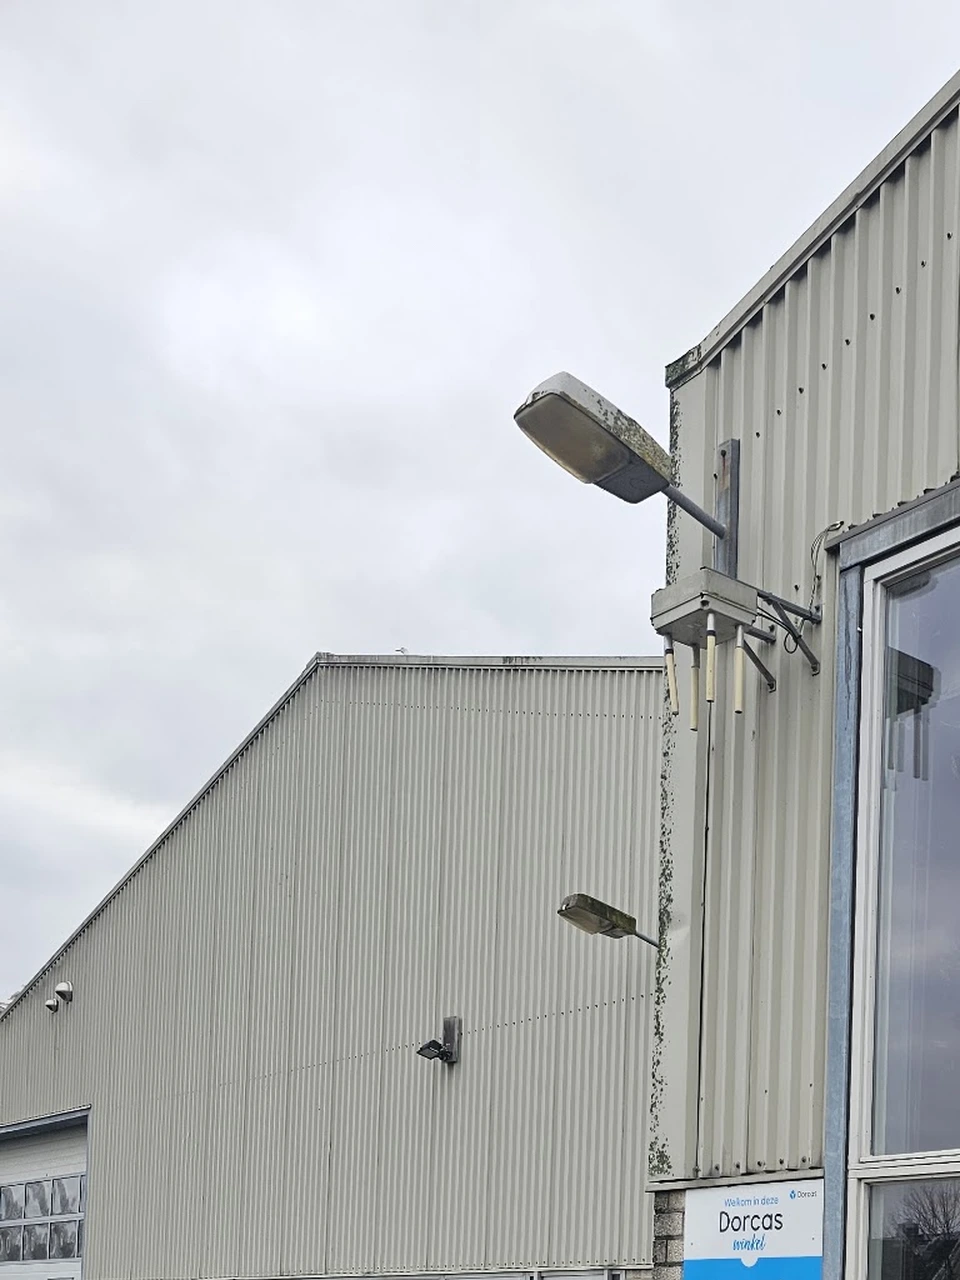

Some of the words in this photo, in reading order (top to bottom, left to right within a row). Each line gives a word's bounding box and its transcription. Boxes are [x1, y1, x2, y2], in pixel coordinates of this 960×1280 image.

[724, 1197, 752, 1208] Welkom
[753, 1196, 760, 1206] in
[760, 1195, 779, 1206] deze
[797, 1190, 817, 1198] Dorcas
[719, 1211, 784, 1233] Dorcas
[732, 1234, 766, 1251] winkel
